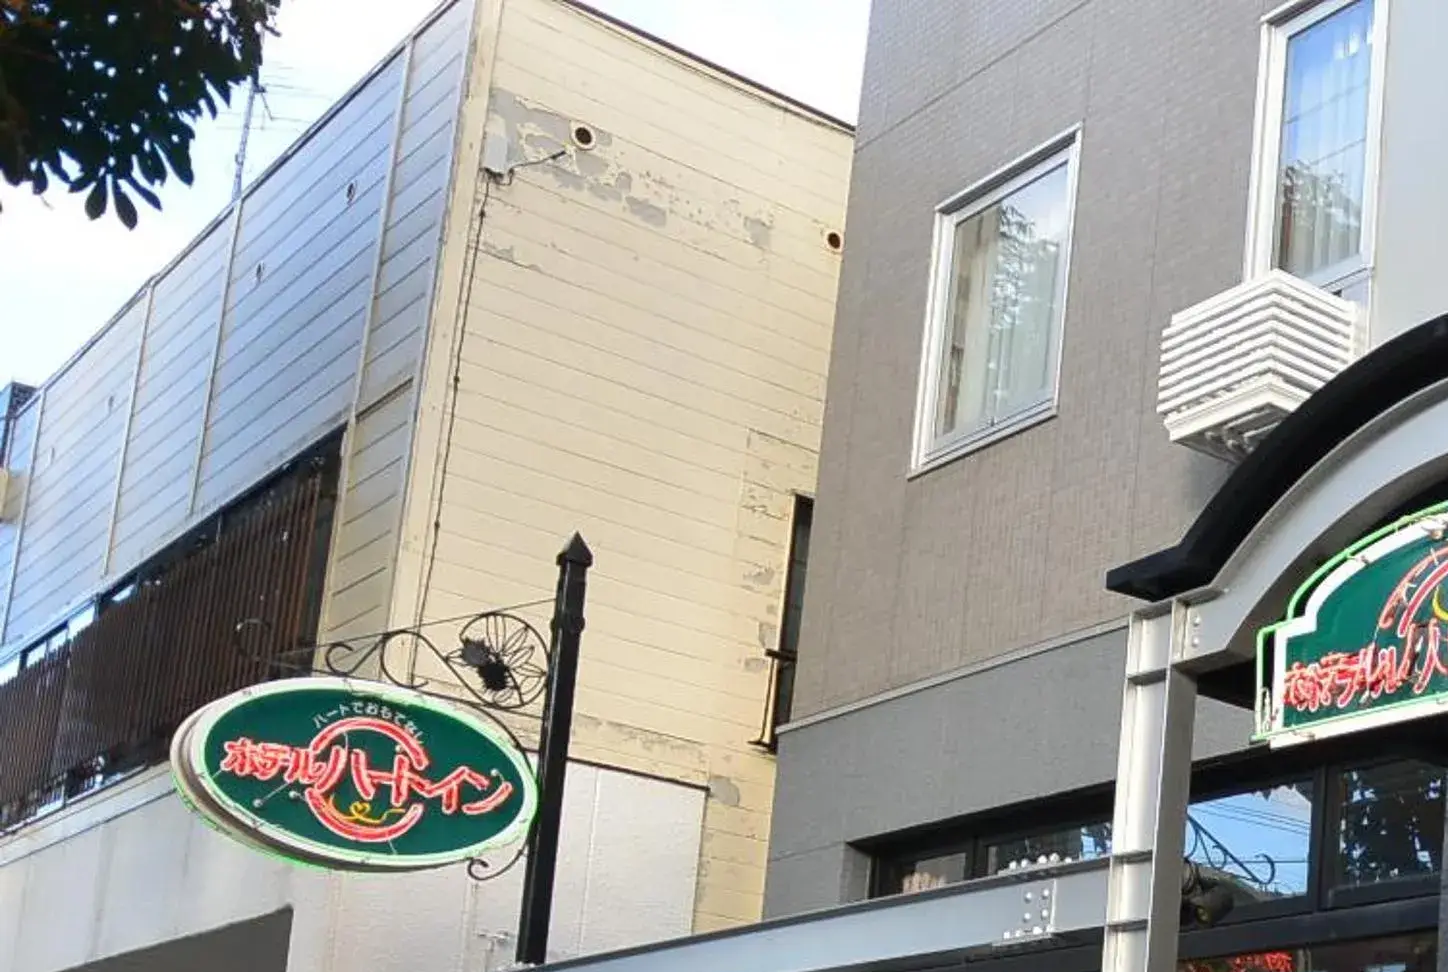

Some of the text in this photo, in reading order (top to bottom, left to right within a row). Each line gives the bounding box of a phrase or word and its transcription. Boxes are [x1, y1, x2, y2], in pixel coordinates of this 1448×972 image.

[221, 736, 514, 815] ホテルハートイン
